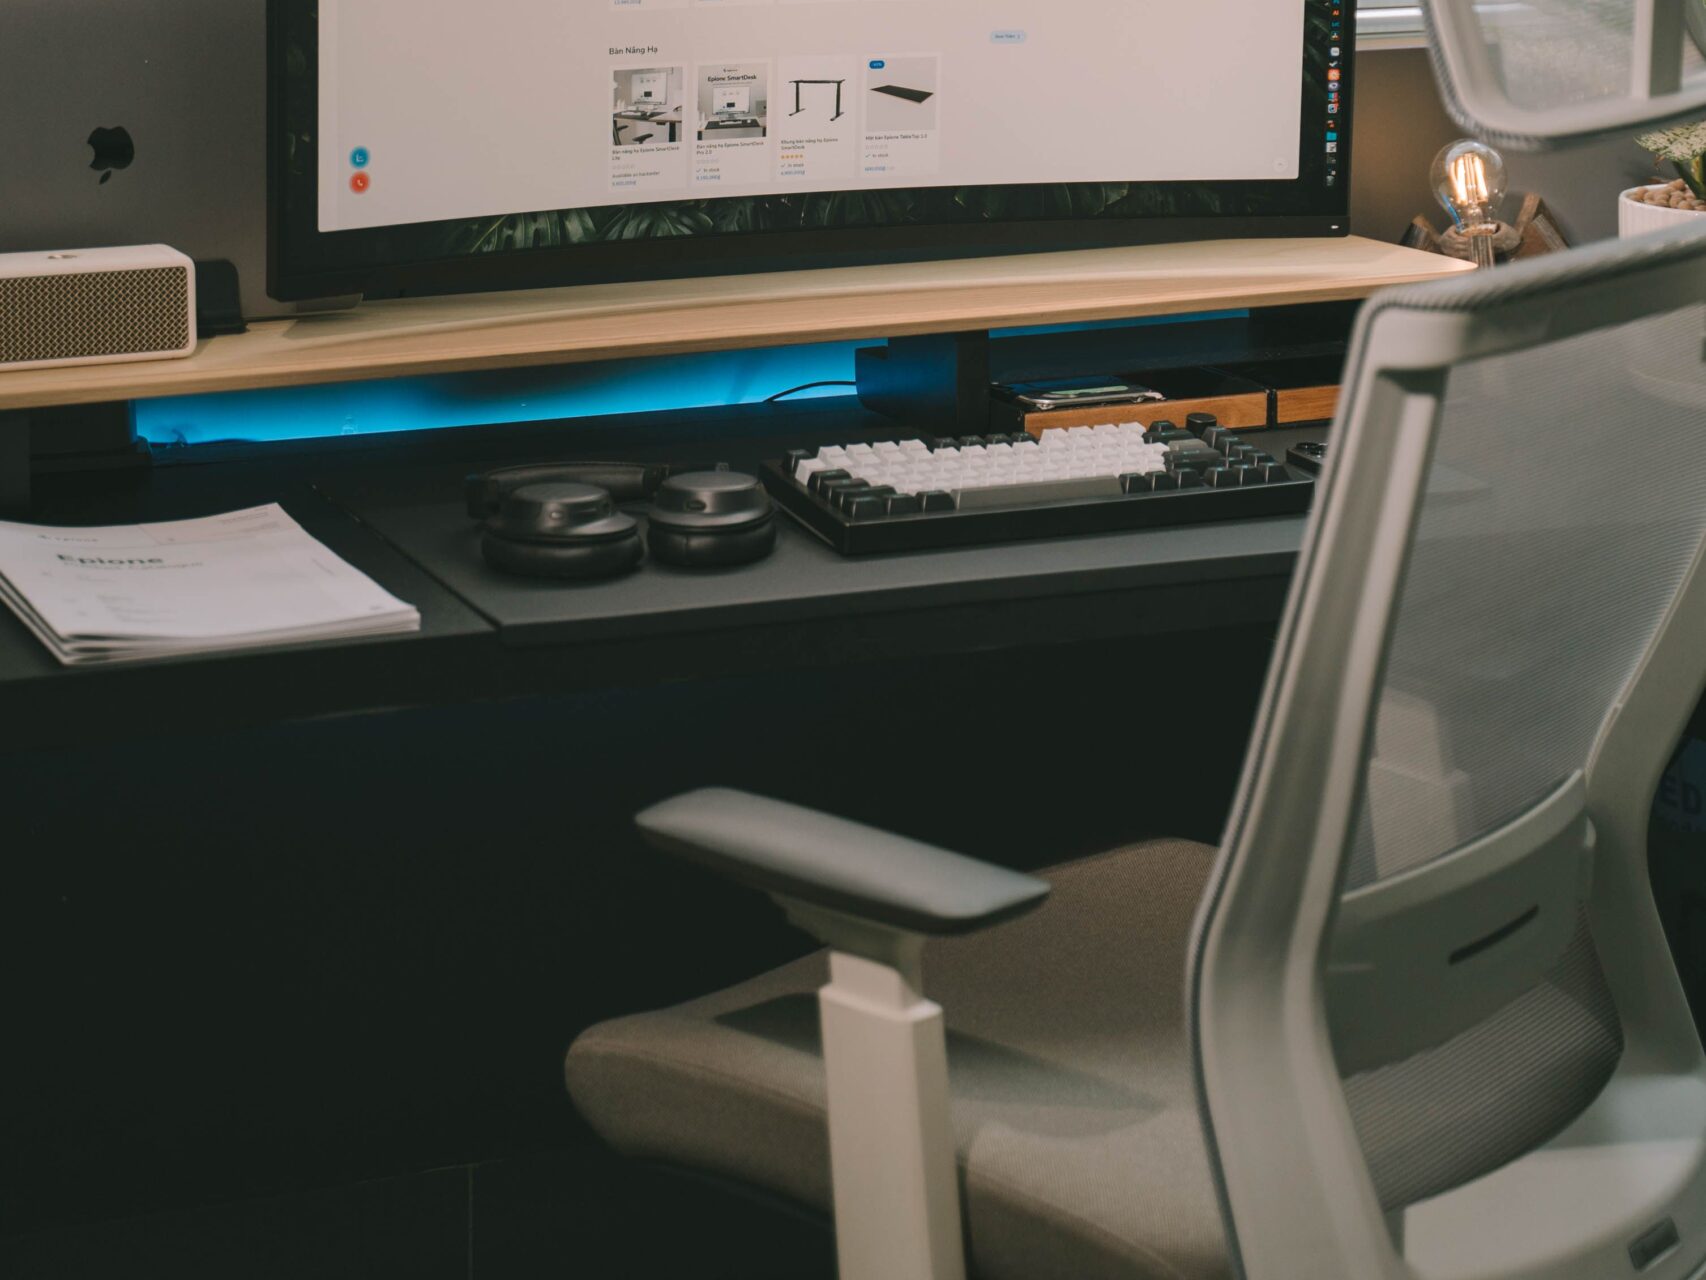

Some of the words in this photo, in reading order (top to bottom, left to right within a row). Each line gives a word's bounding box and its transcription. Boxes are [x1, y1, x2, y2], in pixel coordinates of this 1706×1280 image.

[625, 46, 645, 55] Nâng
[647, 46, 658, 54] Hạ
[56, 553, 164, 566] Epione
